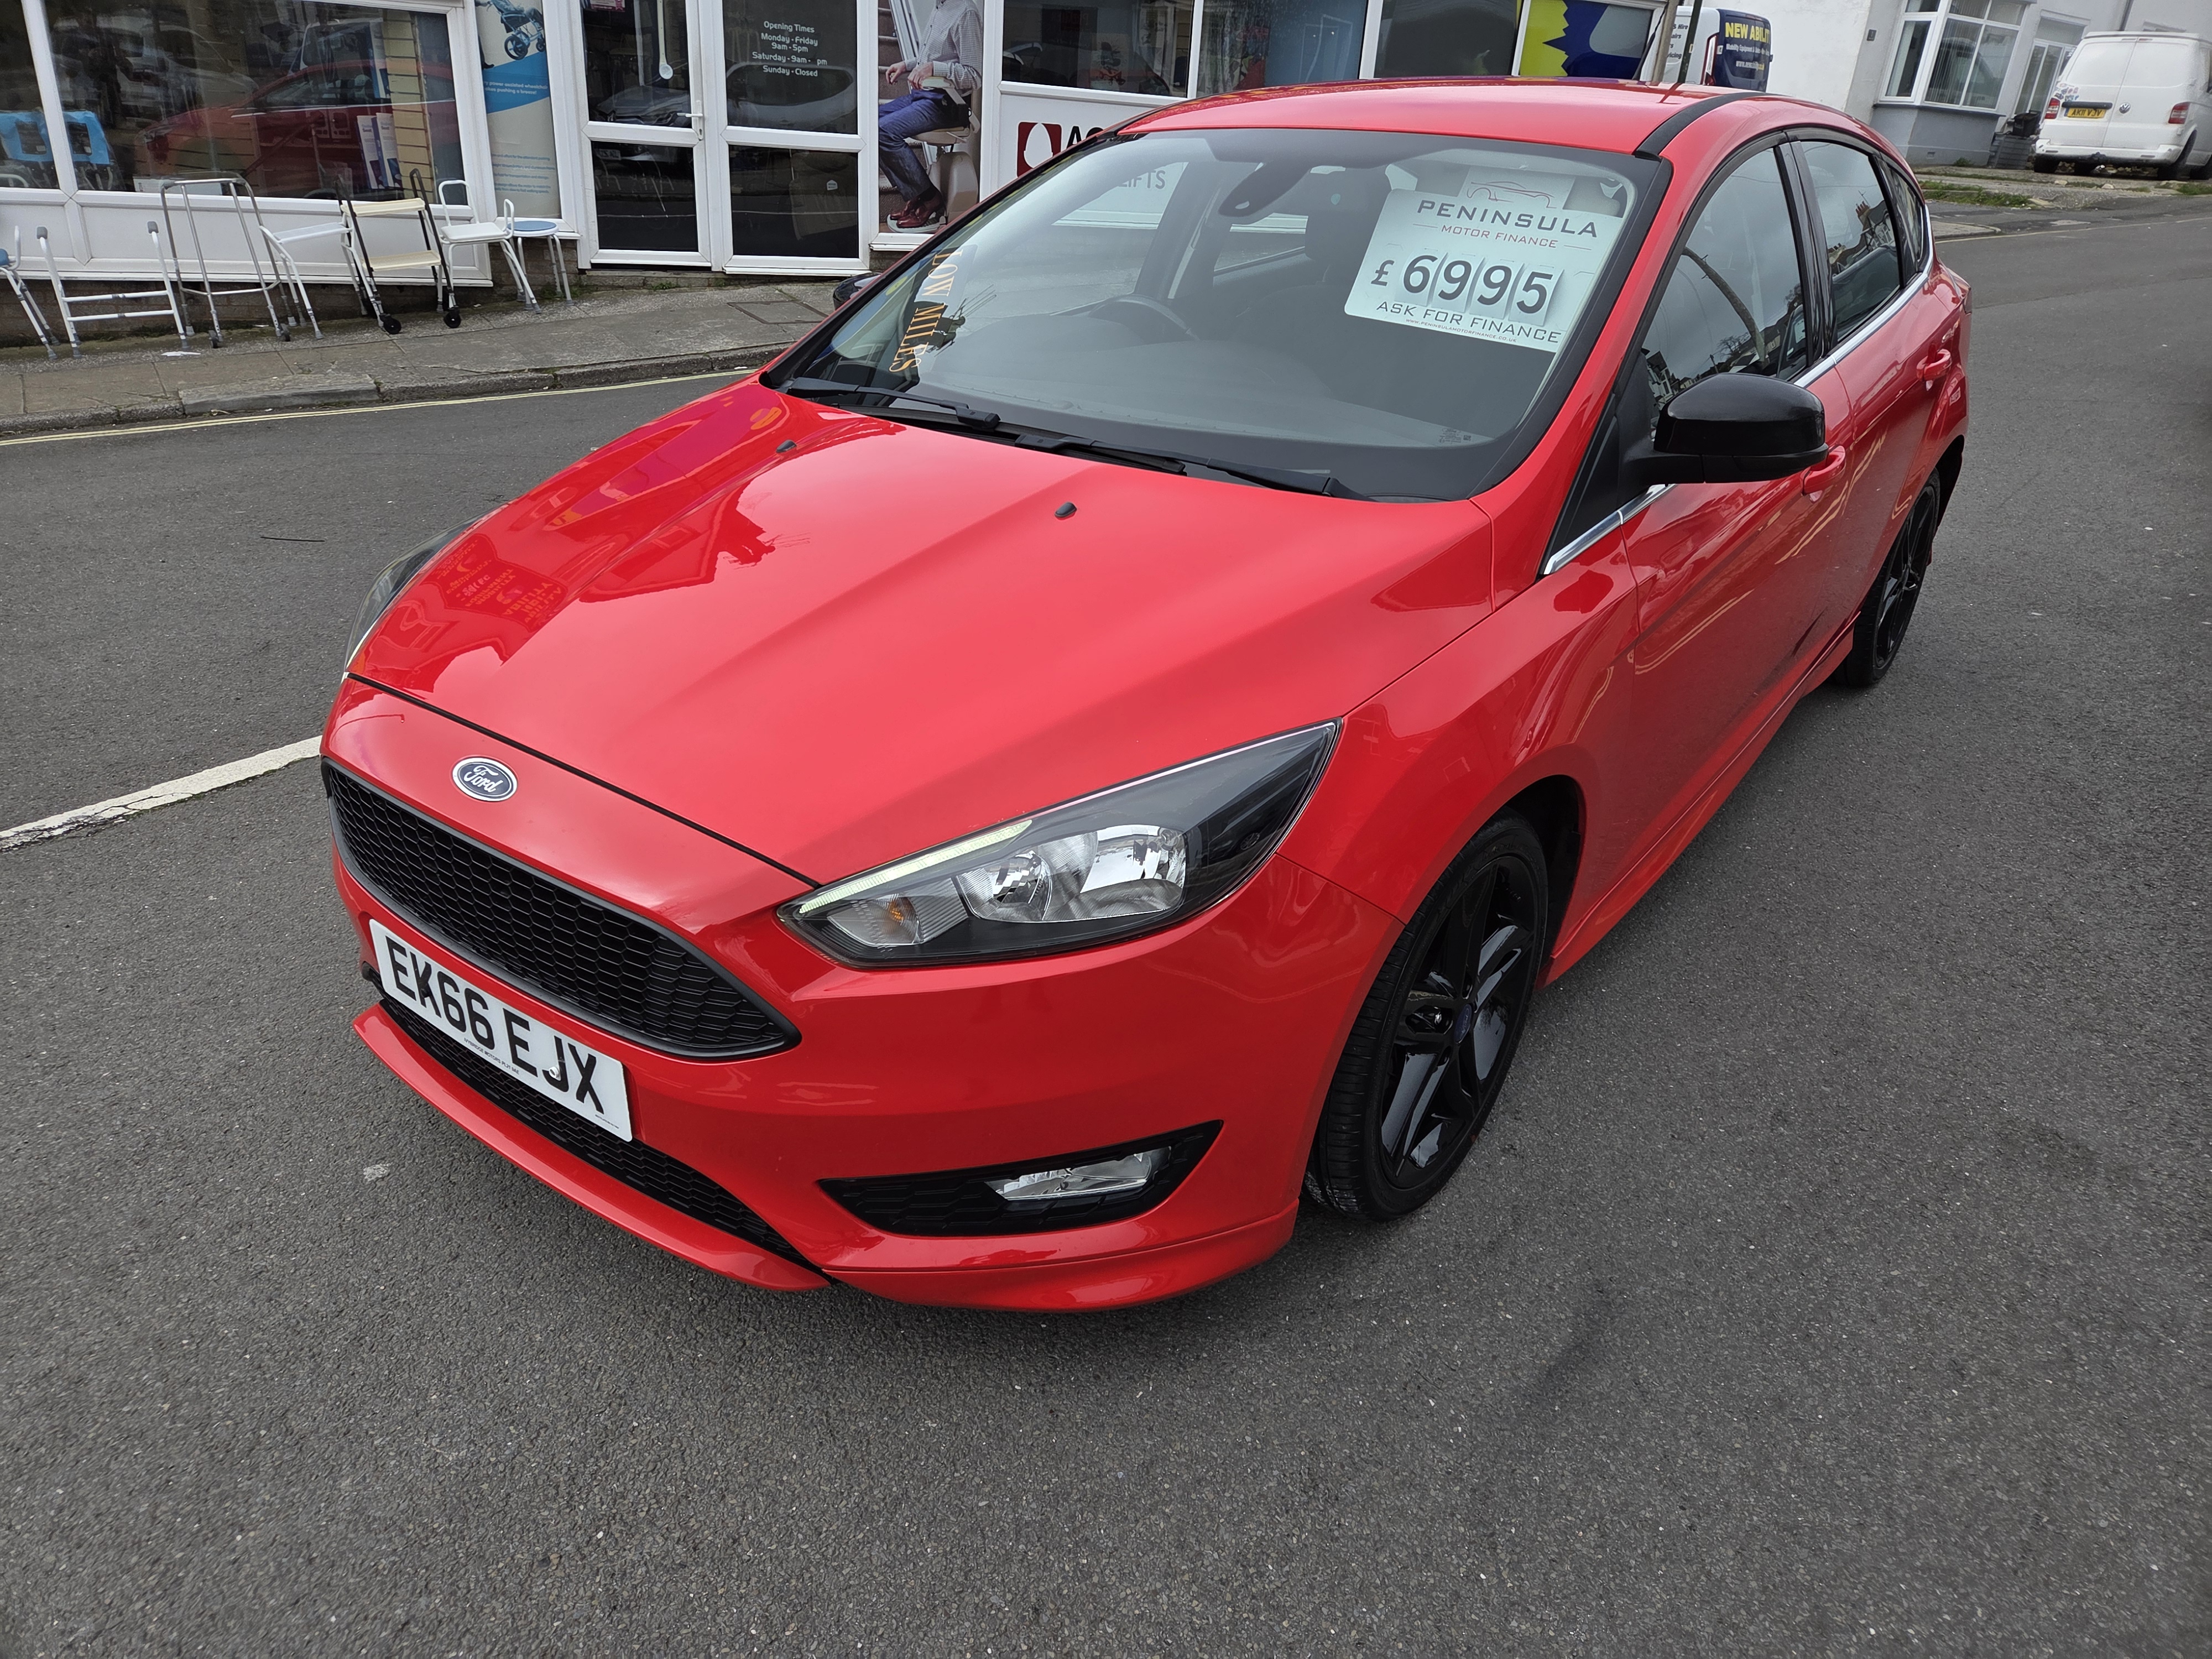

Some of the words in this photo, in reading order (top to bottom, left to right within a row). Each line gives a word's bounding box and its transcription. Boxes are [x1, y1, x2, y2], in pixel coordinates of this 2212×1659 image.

[761, 33, 790, 44] Monday
[795, 36, 818, 46] Friday
[764, 21, 793, 32] Opening
[794, 24, 815, 33] Times
[1725, 22, 1748, 39] NEW
[752, 51, 786, 62] Saturday
[771, 42, 787, 50] 9am
[792, 44, 808, 53] 5pm
[763, 65, 790, 76] Sunday
[795, 68, 818, 76] Closed
[1417, 200, 1598, 238] PENINSULA
[1441, 225, 1490, 239] MOTOR
[1495, 232, 1558, 248] FINANCE
[921, 249, 963, 296] LOW
[1370, 260, 1395, 286] £
[1403, 255, 1553, 314] 6995
[1376, 301, 1417, 317] ASK
[1423, 308, 1463, 325] FOR
[1470, 317, 1562, 344] FINANCE
[889, 302, 946, 372] MILES
[463, 765, 504, 792] Ford
[385, 935, 495, 1050] EK66
[503, 1008, 604, 1115] EJX
